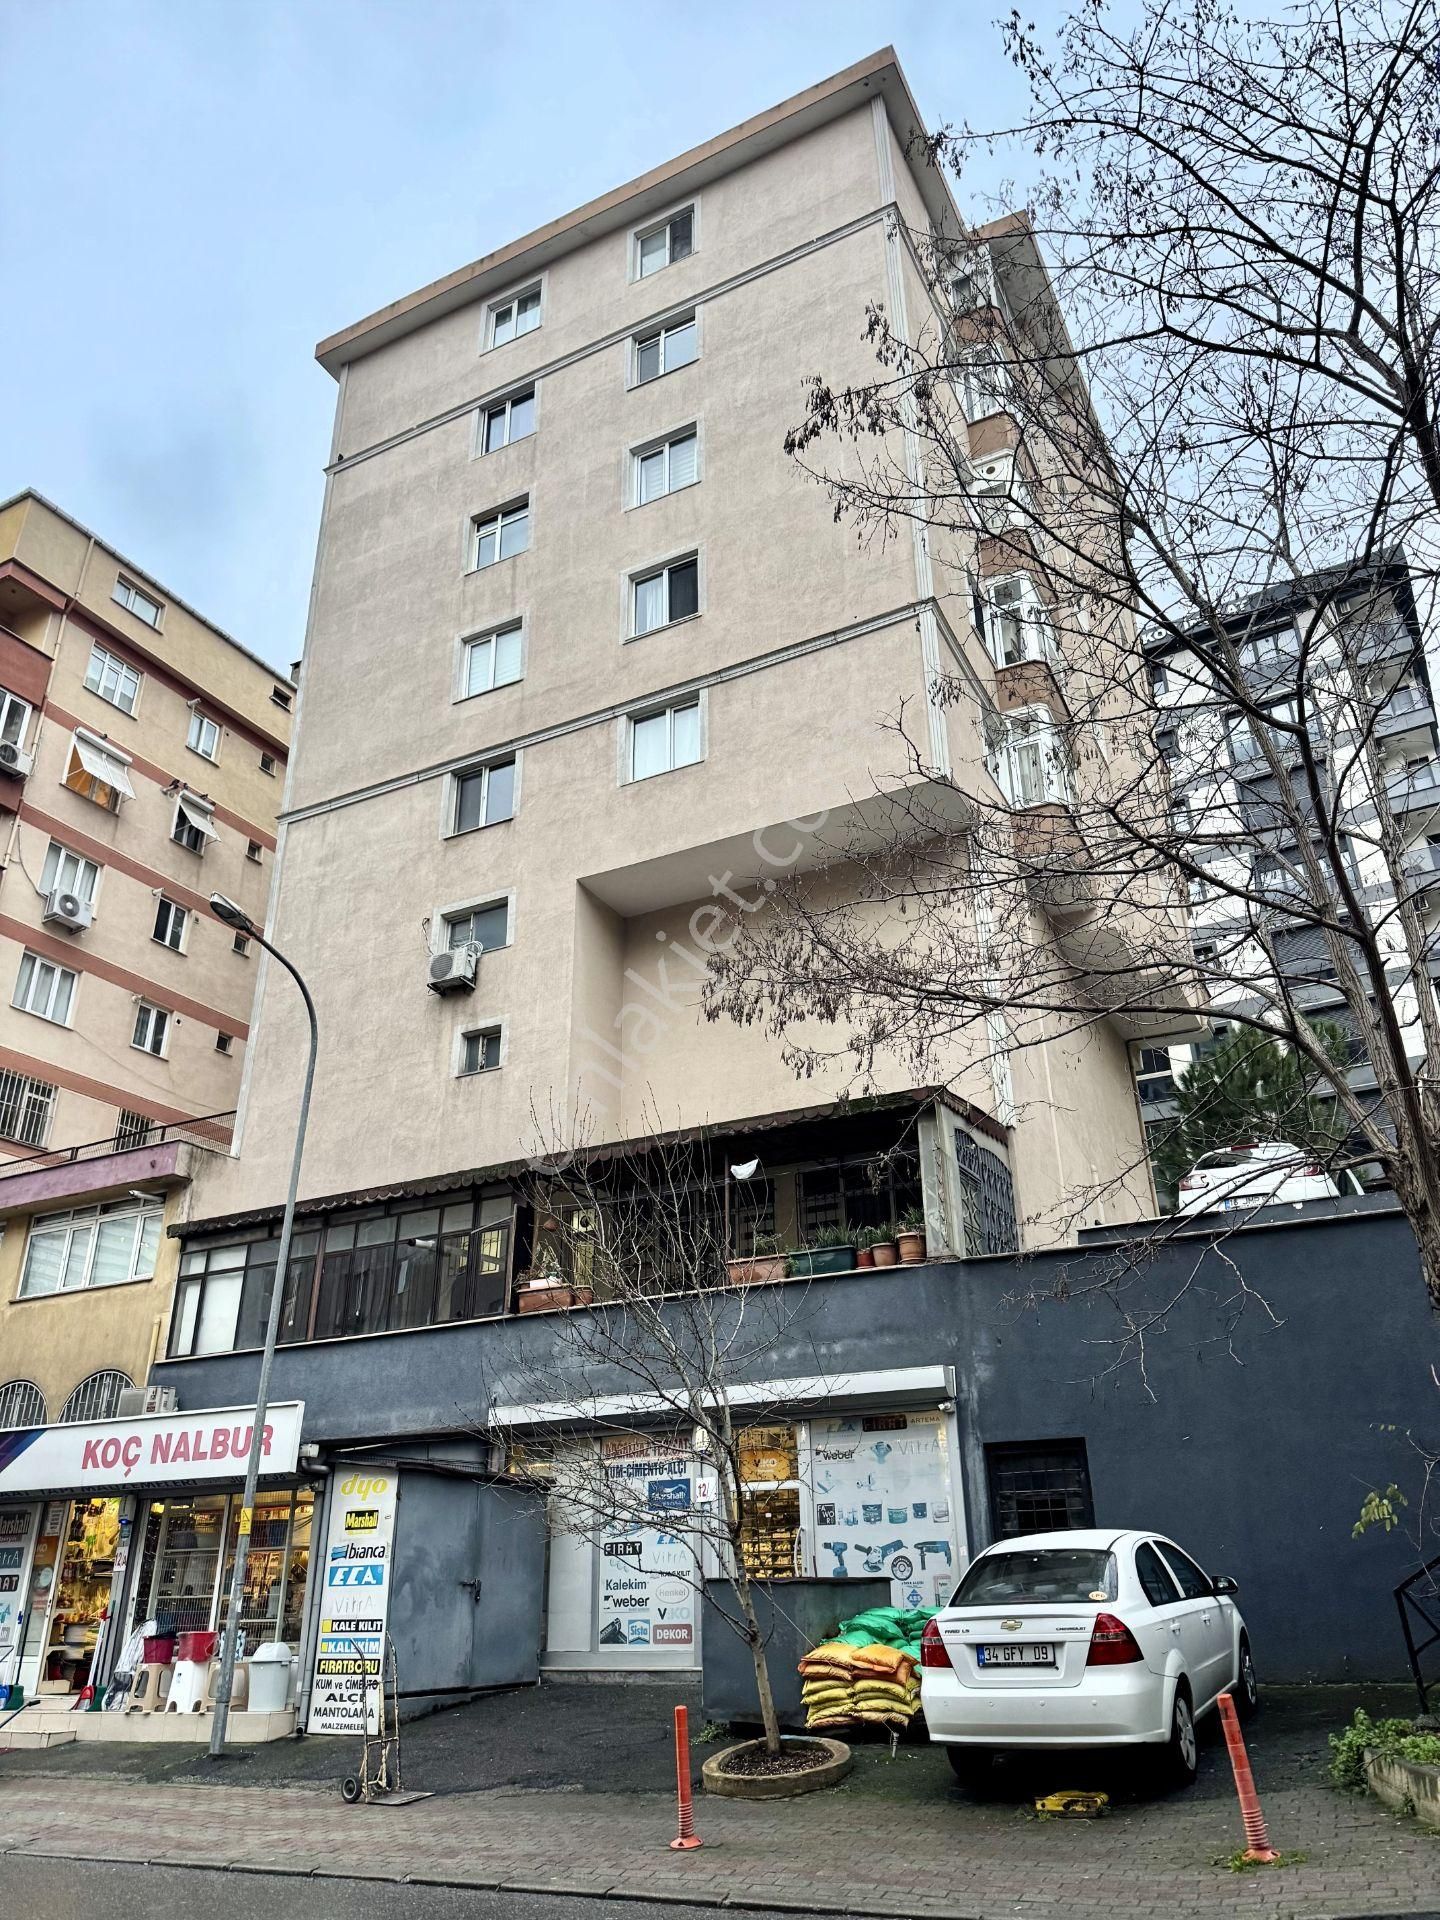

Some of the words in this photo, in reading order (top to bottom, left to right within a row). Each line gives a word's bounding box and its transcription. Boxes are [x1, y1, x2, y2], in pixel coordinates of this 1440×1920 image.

[910, 1416, 940, 1424] ARTEMA
[81, 1434, 142, 1478] KOÇ
[150, 1424, 274, 1465] NALBUR
[822, 1448, 855, 1461] weber
[341, 1474, 388, 1501] dyo
[345, 1512, 378, 1528] Marshall
[348, 1543, 385, 1559] bianca
[605, 1543, 640, 1555] FIRAT
[605, 1579, 647, 1591] Kalekim
[659, 1588, 686, 1597] Henkel
[613, 1595, 650, 1608] weber
[332, 1621, 356, 1631] KALE
[630, 1625, 648, 1635] Sista
[985, 1647, 999, 1661] 34
[1003, 1646, 1024, 1661] GFY
[1034, 1645, 1048, 1660] 09
[315, 1679, 332, 1689] KUM
[345, 1676, 378, 1692] ÇİMETO
